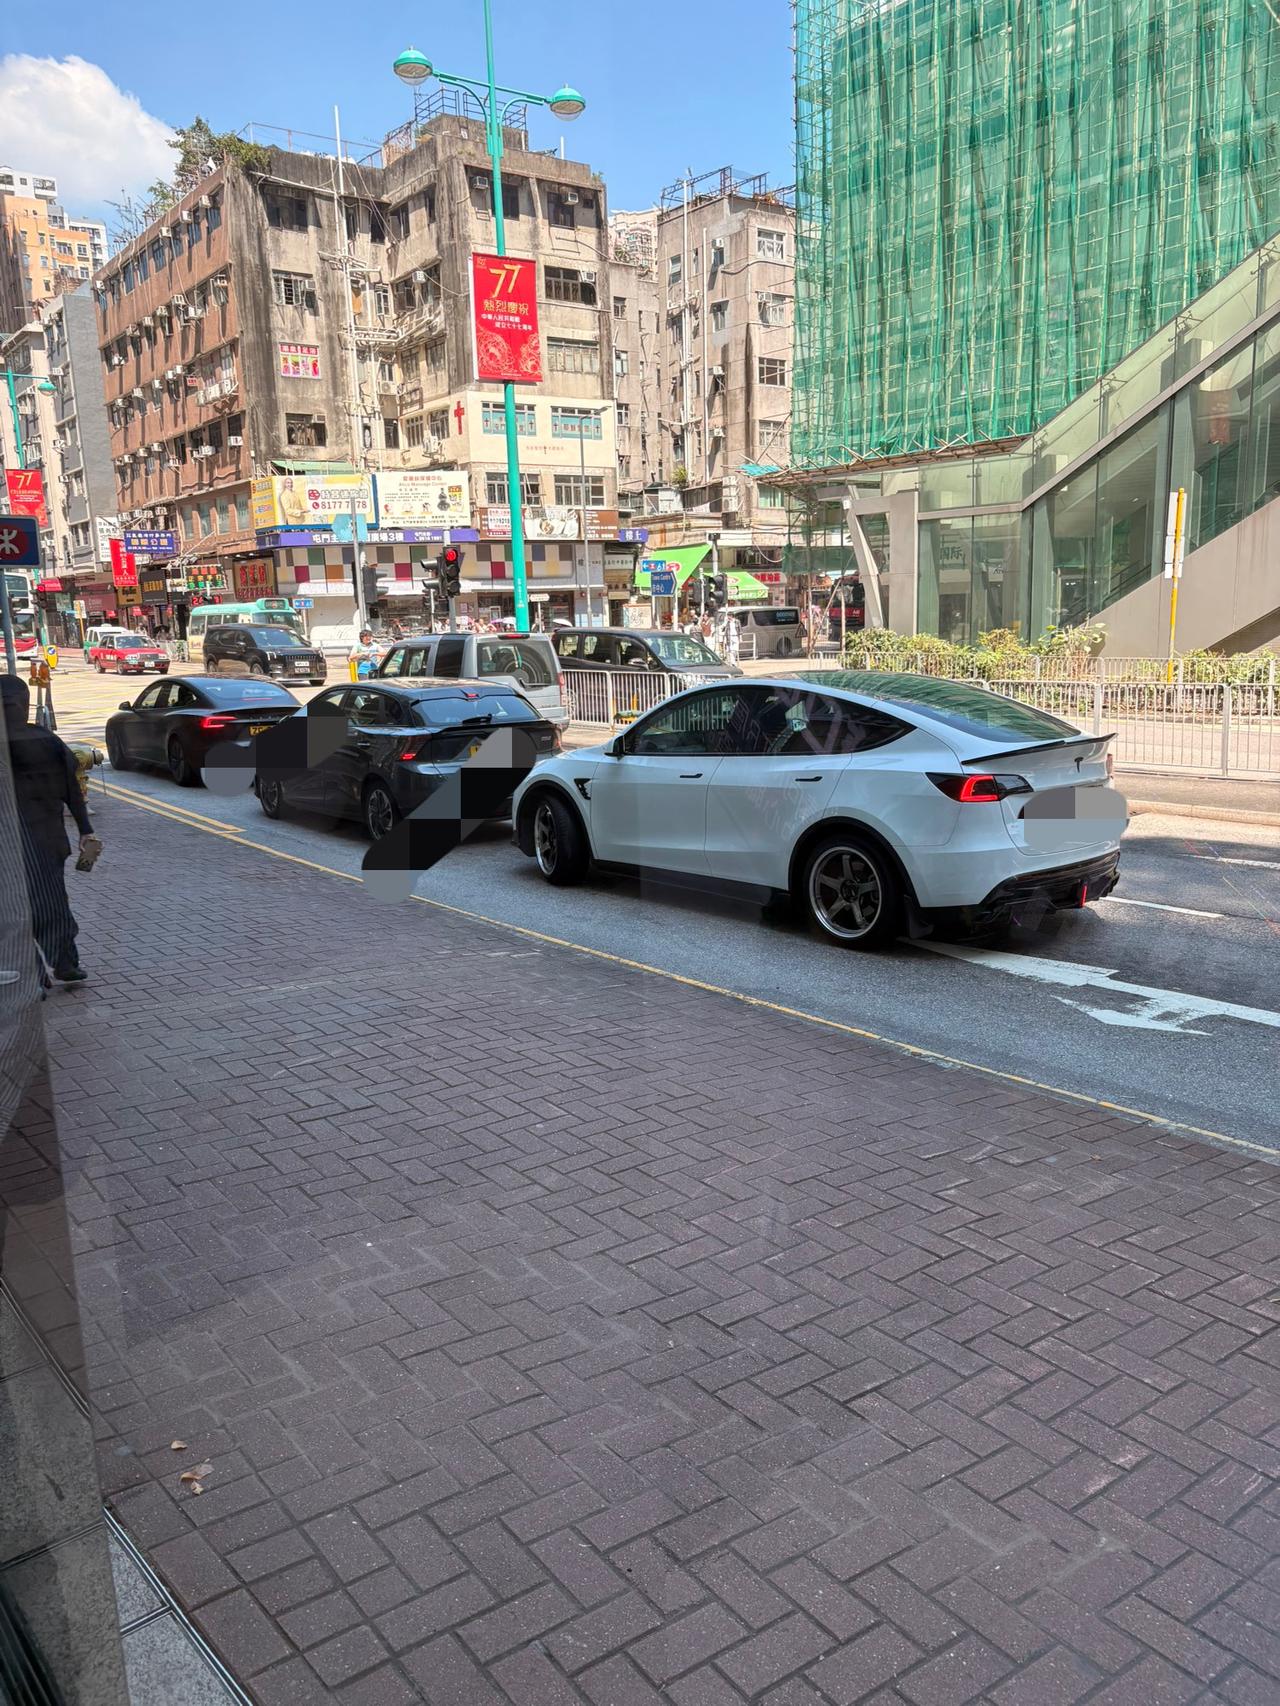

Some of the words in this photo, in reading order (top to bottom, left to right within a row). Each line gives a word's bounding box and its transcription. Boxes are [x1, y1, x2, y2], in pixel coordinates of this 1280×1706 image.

[489, 264, 524, 298] 77
[484, 299, 529, 315] 熱烈慶祝
[15, 472, 33, 489] 77
[321, 501, 342, 509] 8177
[345, 500, 367, 509] 778
